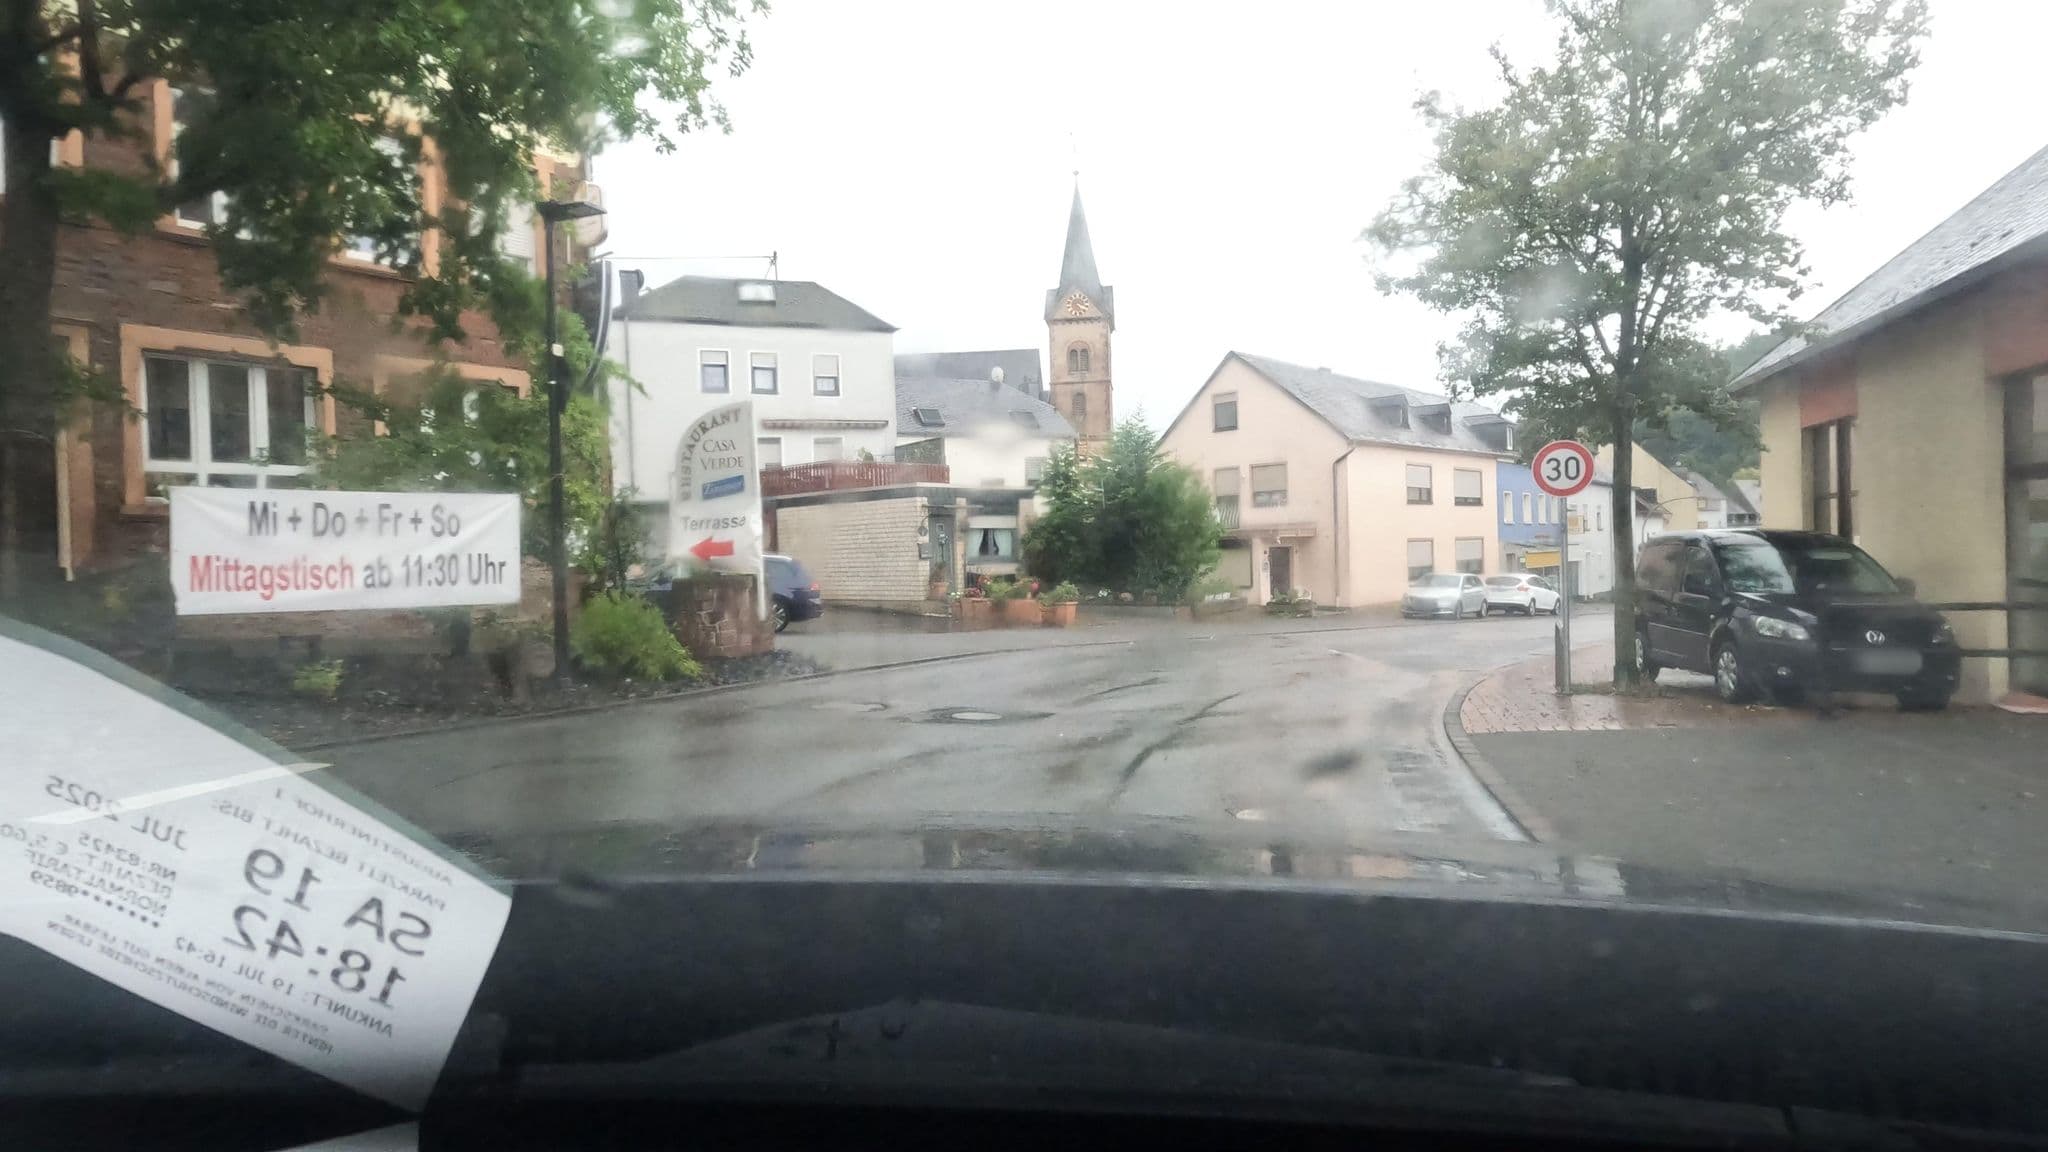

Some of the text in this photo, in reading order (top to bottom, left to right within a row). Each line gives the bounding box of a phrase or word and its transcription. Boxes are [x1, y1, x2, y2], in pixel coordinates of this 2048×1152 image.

[681, 408, 741, 502] RESTAURANT
[702, 439, 736, 453] CASA
[699, 456, 744, 471] VERDE
[1545, 456, 1581, 482] 30
[248, 501, 278, 537] Mi
[313, 502, 345, 538] Do
[378, 503, 403, 537] Fr
[431, 504, 460, 538] So
[190, 552, 507, 601] Mittagstisch ab 11:30 Uhr
